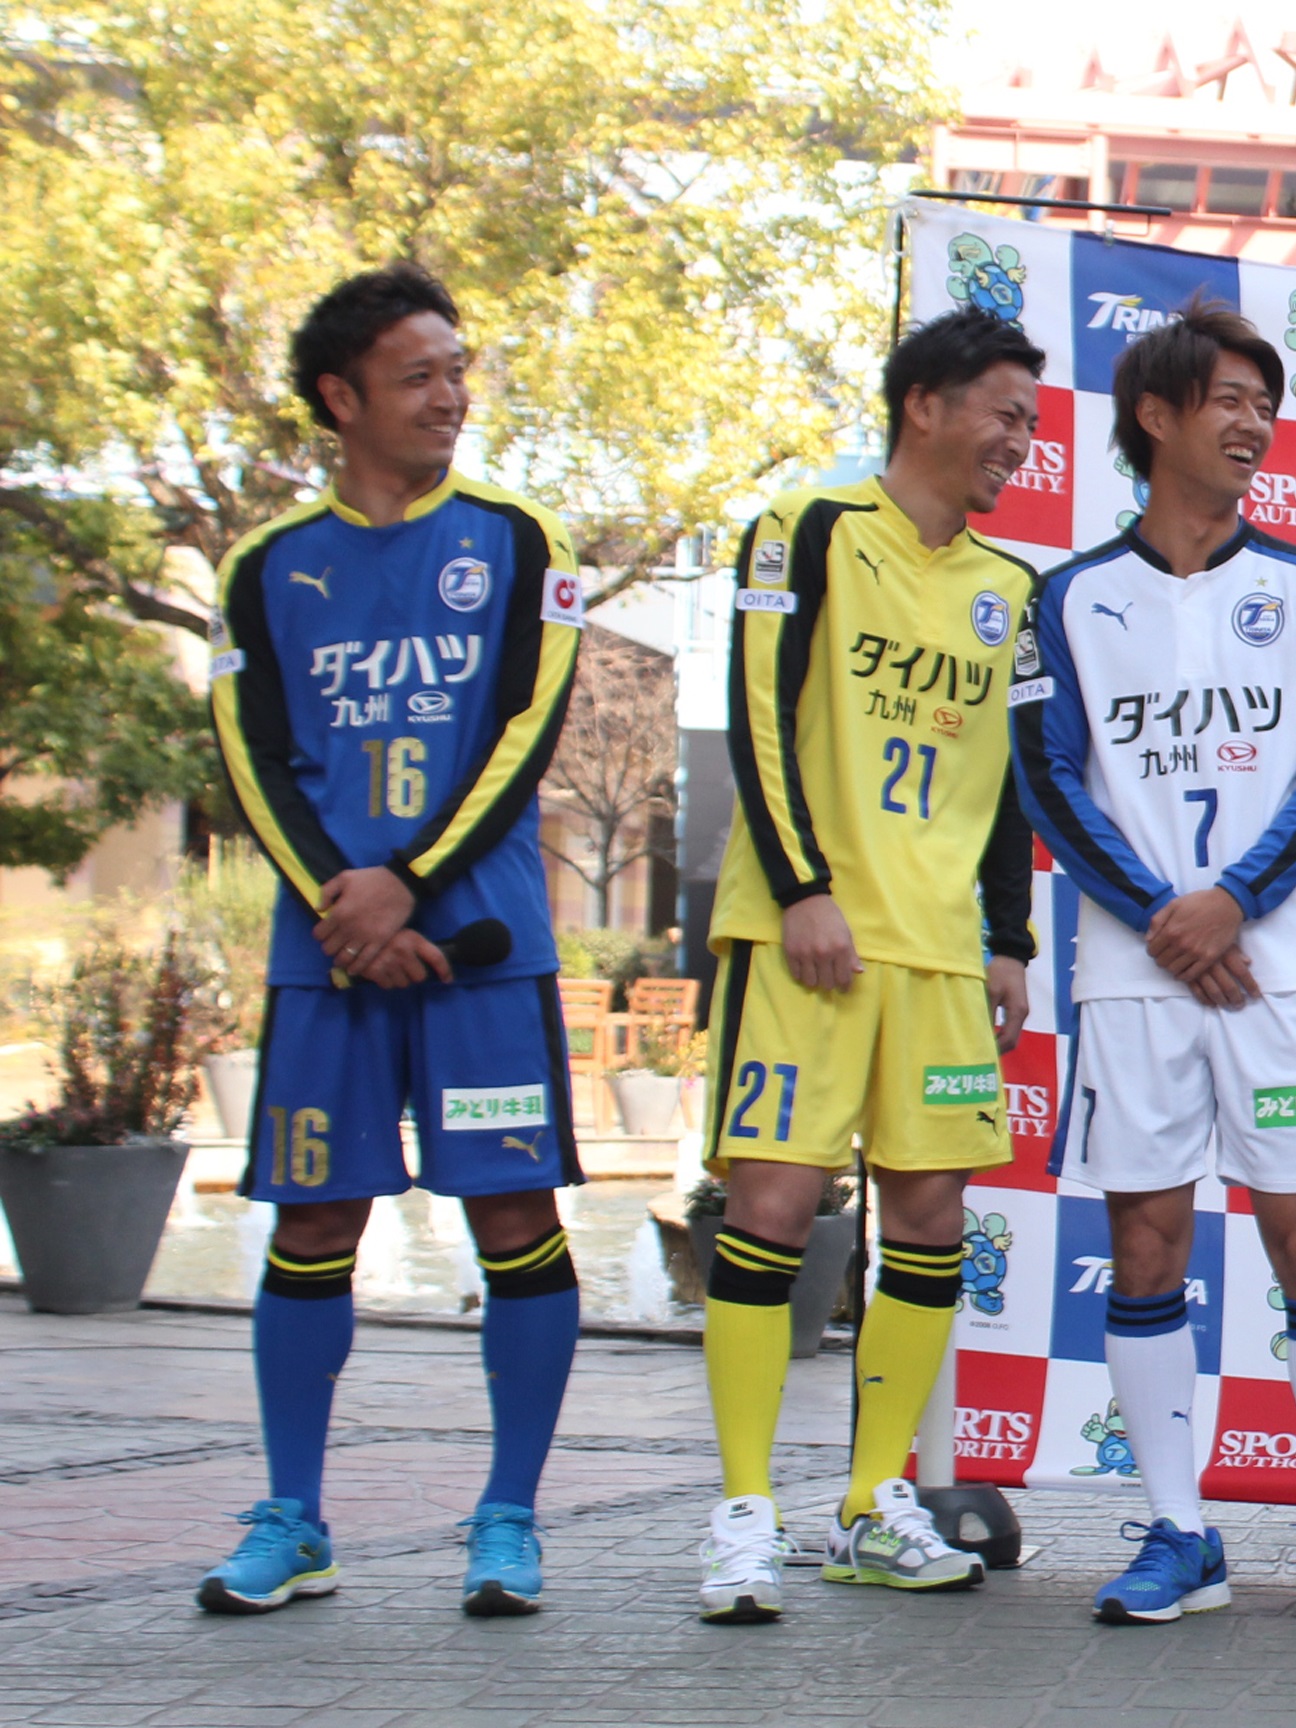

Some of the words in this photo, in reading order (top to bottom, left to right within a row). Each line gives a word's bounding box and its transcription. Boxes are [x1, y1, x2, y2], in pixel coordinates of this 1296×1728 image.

[743, 594, 786, 608] OITA
[310, 634, 483, 695] ダイハツ
[849, 632, 993, 706] ダイハツ
[1011, 683, 1045, 700] OITA
[330, 693, 390, 727] 九州
[865, 688, 916, 726] 九州
[1104, 686, 1282, 744] ダイハツ
[362, 736, 428, 819] 16
[880, 736, 938, 820] 21
[1139, 744, 1198, 779] 九州
[1183, 788, 1218, 868] 7
[727, 1060, 798, 1142] 21
[267, 1106, 331, 1187] 16
[954, 1407, 1032, 1442] RTS
